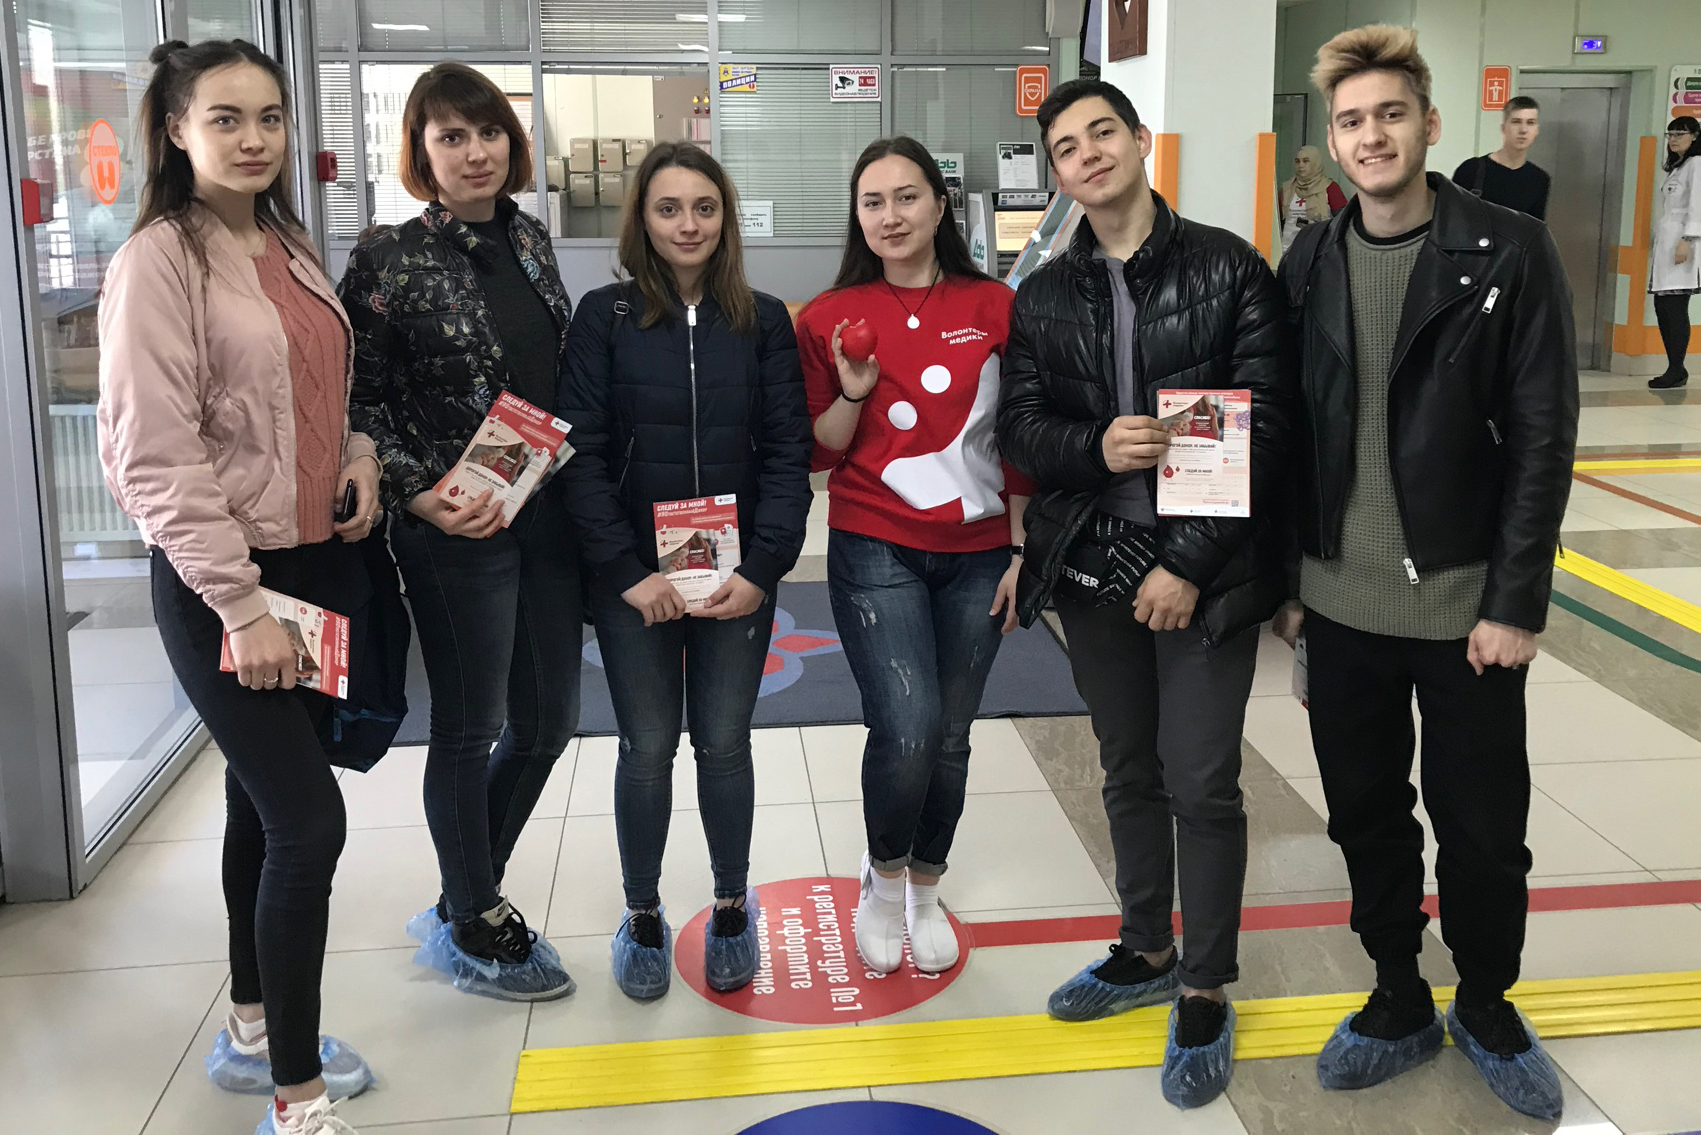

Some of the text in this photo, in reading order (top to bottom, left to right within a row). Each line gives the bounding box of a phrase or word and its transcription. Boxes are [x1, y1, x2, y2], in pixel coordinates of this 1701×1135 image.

[723, 75, 755, 88] ПОЛИЦИИ
[941, 327, 988, 339] Волонтеры
[949, 334, 983, 345] медики
[502, 394, 524, 408] СЛЕДУЙ
[528, 406, 547, 420] МНОЙ!
[657, 502, 678, 512] СЛЕДУЙ
[688, 500, 707, 508] МНОЙ!
[776, 907, 813, 989] и оформите
[806, 885, 863, 1012] к регистратуре №1
